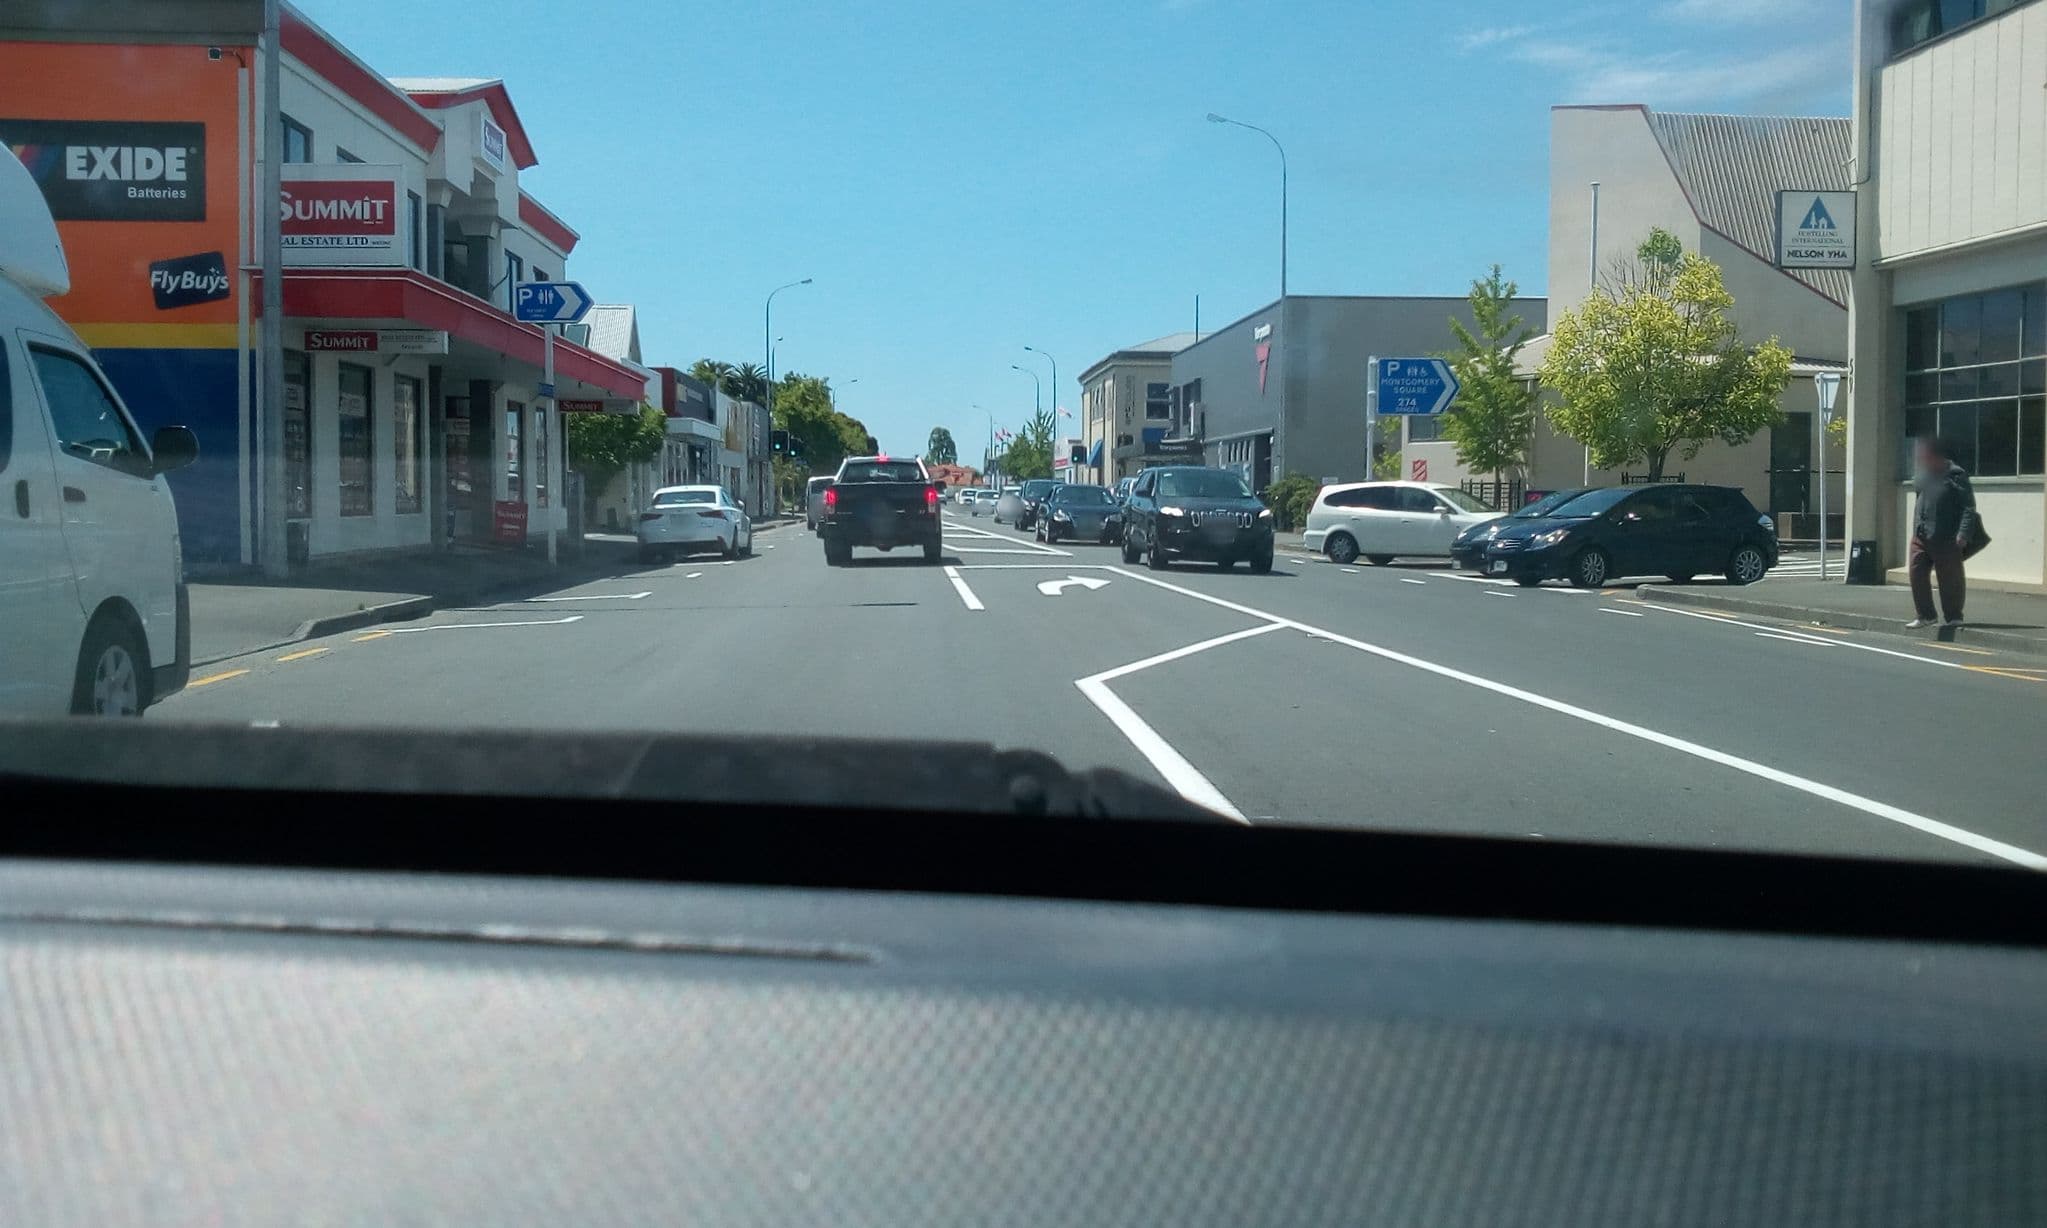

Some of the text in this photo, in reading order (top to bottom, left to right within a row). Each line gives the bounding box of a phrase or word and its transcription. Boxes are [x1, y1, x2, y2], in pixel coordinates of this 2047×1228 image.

[66, 146, 187, 181] EXIDE
[127, 186, 187, 199] Batteries
[301, 236, 344, 246] ESTATE
[347, 236, 369, 246] LTD
[1787, 249, 1848, 258] NELSON YHA
[151, 269, 229, 294] FlyBuys
[518, 288, 533, 306] P
[311, 333, 369, 348] SUMMIT
[1387, 361, 1400, 377] P
[1381, 377, 1441, 385] MONTGOMERY
[1393, 386, 1429, 394] SQUARE
[1398, 398, 1417, 407] 274
